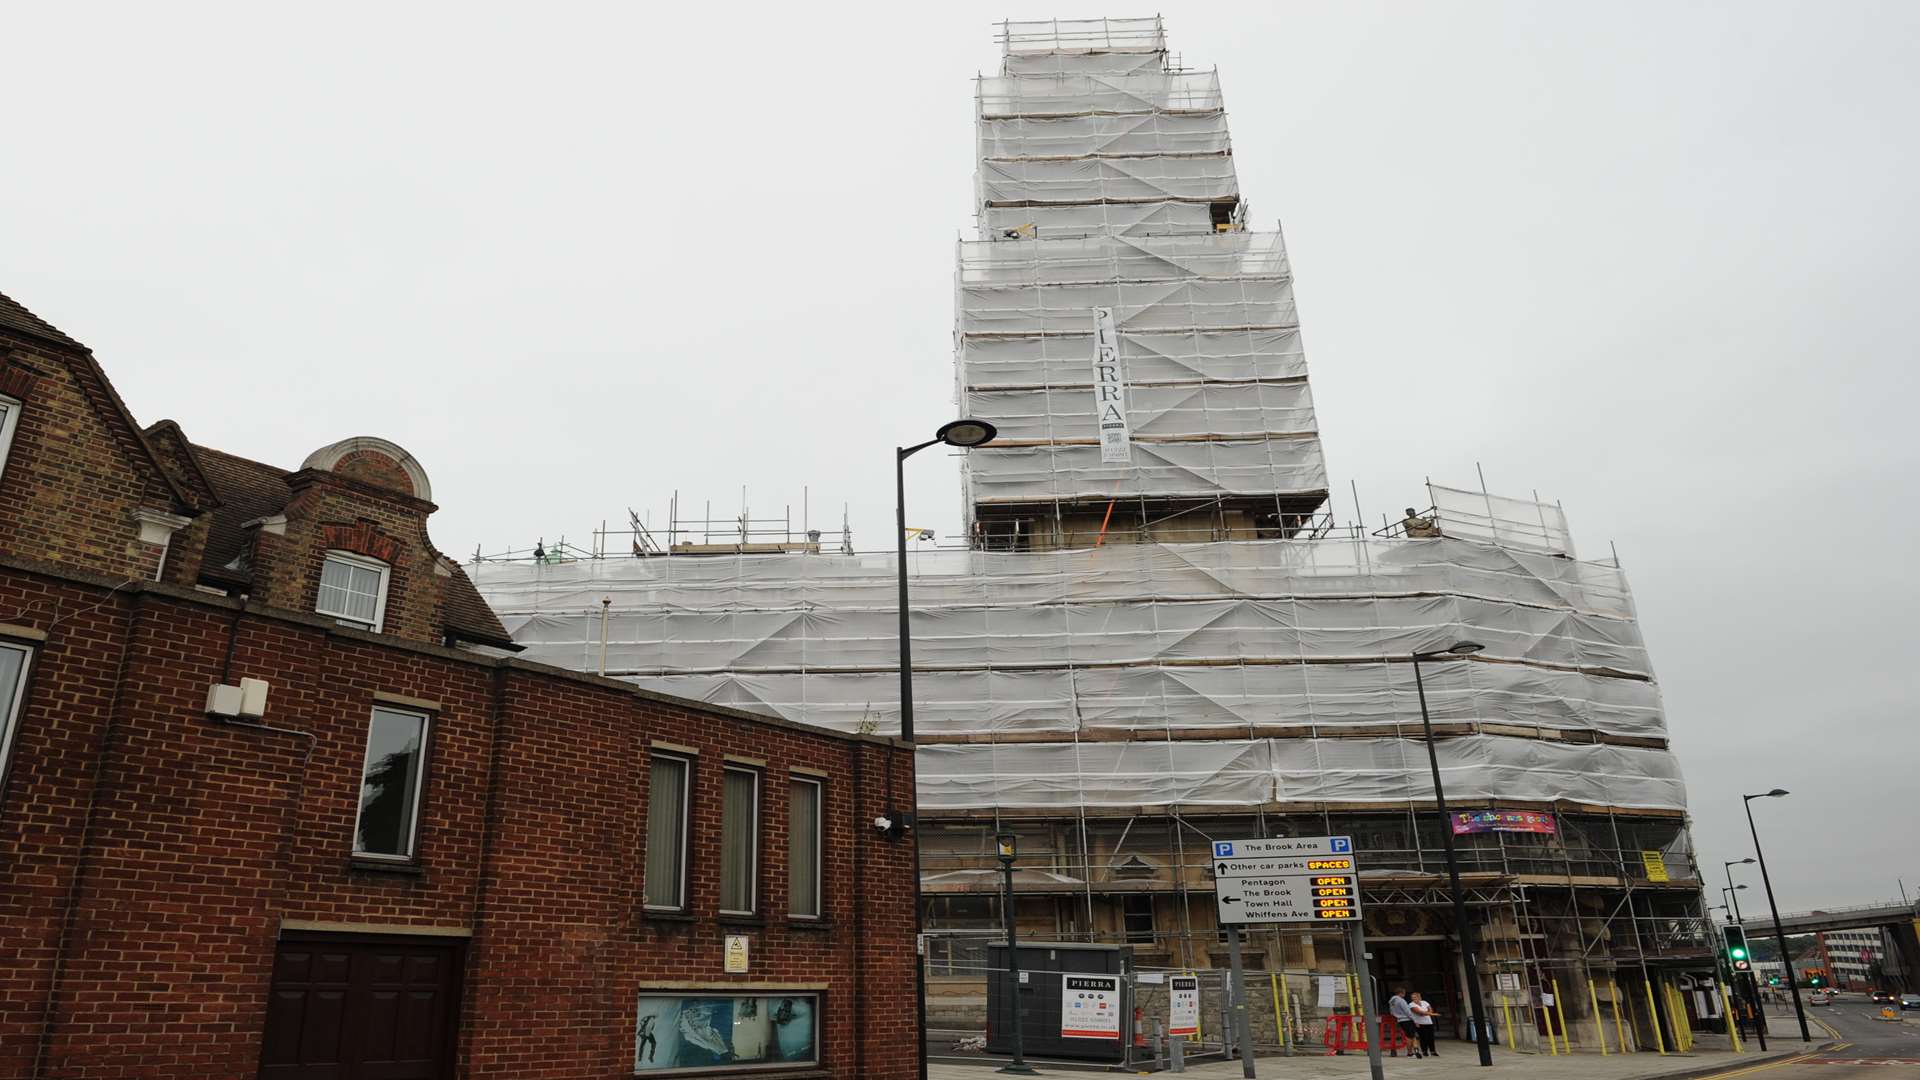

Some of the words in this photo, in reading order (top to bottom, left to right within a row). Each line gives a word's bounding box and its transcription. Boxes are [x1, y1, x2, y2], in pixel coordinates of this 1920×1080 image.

[1245, 844, 1261, 852] The
[1265, 843, 1292, 851] Brook
[1230, 863, 1257, 871] Other
[1278, 861, 1305, 871] parks
[1308, 860, 1350, 870] SPACES
[1241, 879, 1286, 887] Pentagon
[1317, 877, 1345, 885] OPEN
[1264, 888, 1292, 896] Brook
[1318, 888, 1347, 896] OPEN
[1244, 900, 1270, 908] Town
[1273, 899, 1293, 907] Hall
[1320, 899, 1348, 907] OPEN
[1245, 910, 1288, 919] Whiffens
[1292, 910, 1310, 918] Ave
[1321, 910, 1350, 918] OPEN
[1071, 979, 1112, 989] PIERRA
